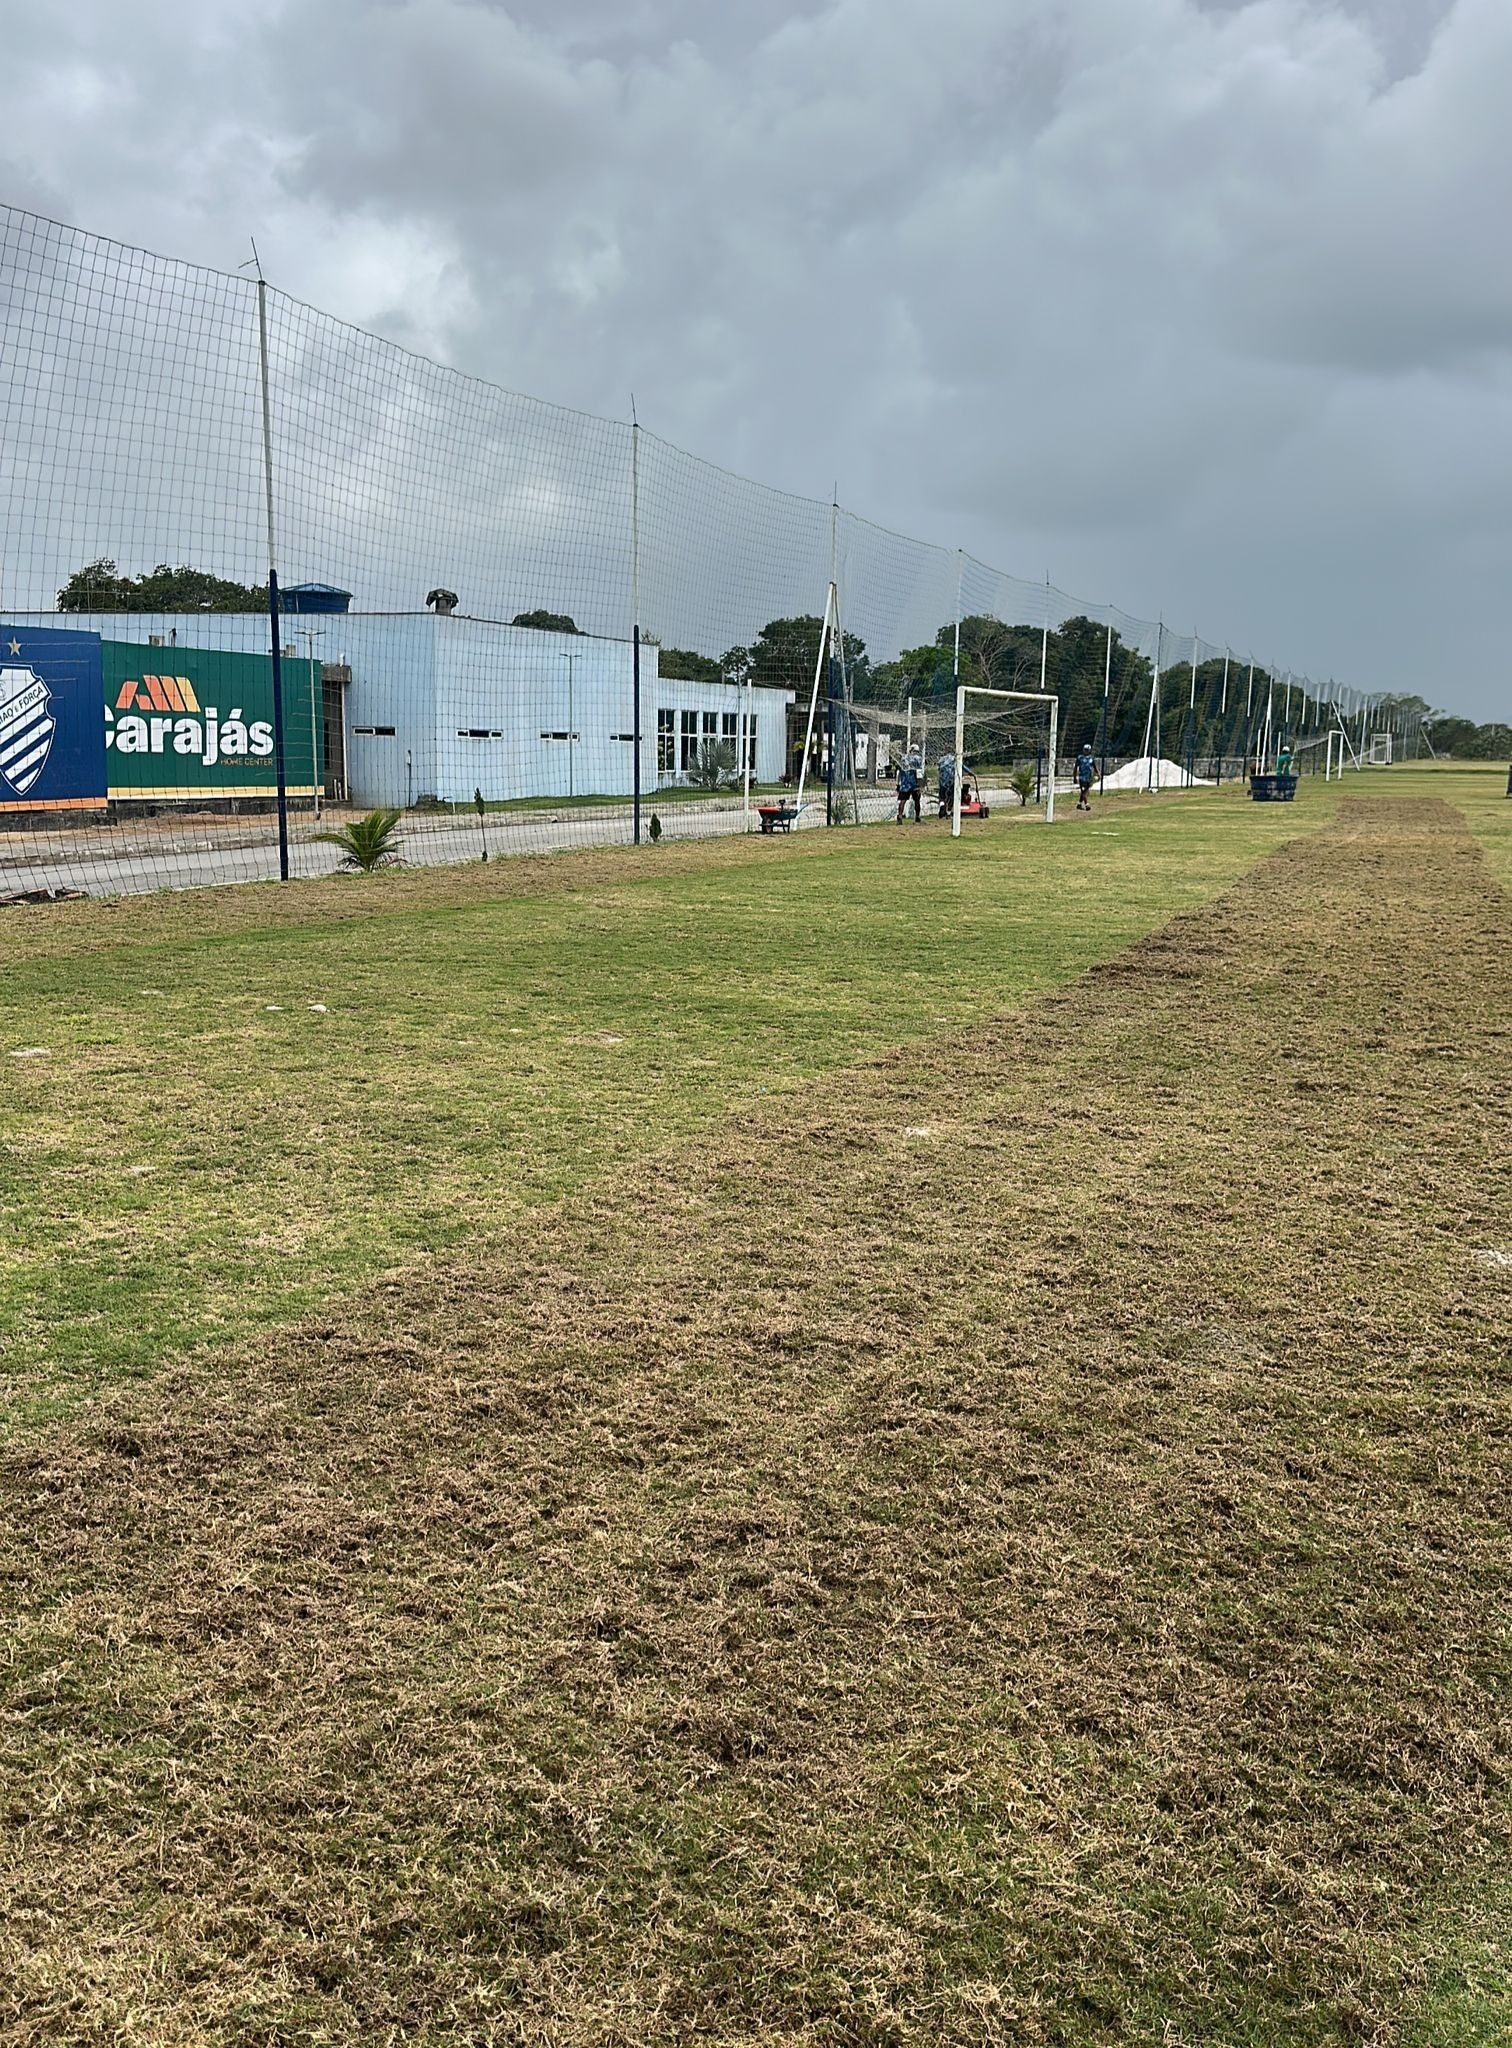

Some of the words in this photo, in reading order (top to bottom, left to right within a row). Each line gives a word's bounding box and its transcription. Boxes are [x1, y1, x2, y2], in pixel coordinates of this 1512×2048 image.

[18, 685, 44, 709] FORÇA
[221, 757, 243, 767] HOME
[244, 757, 274, 767] CENTER
